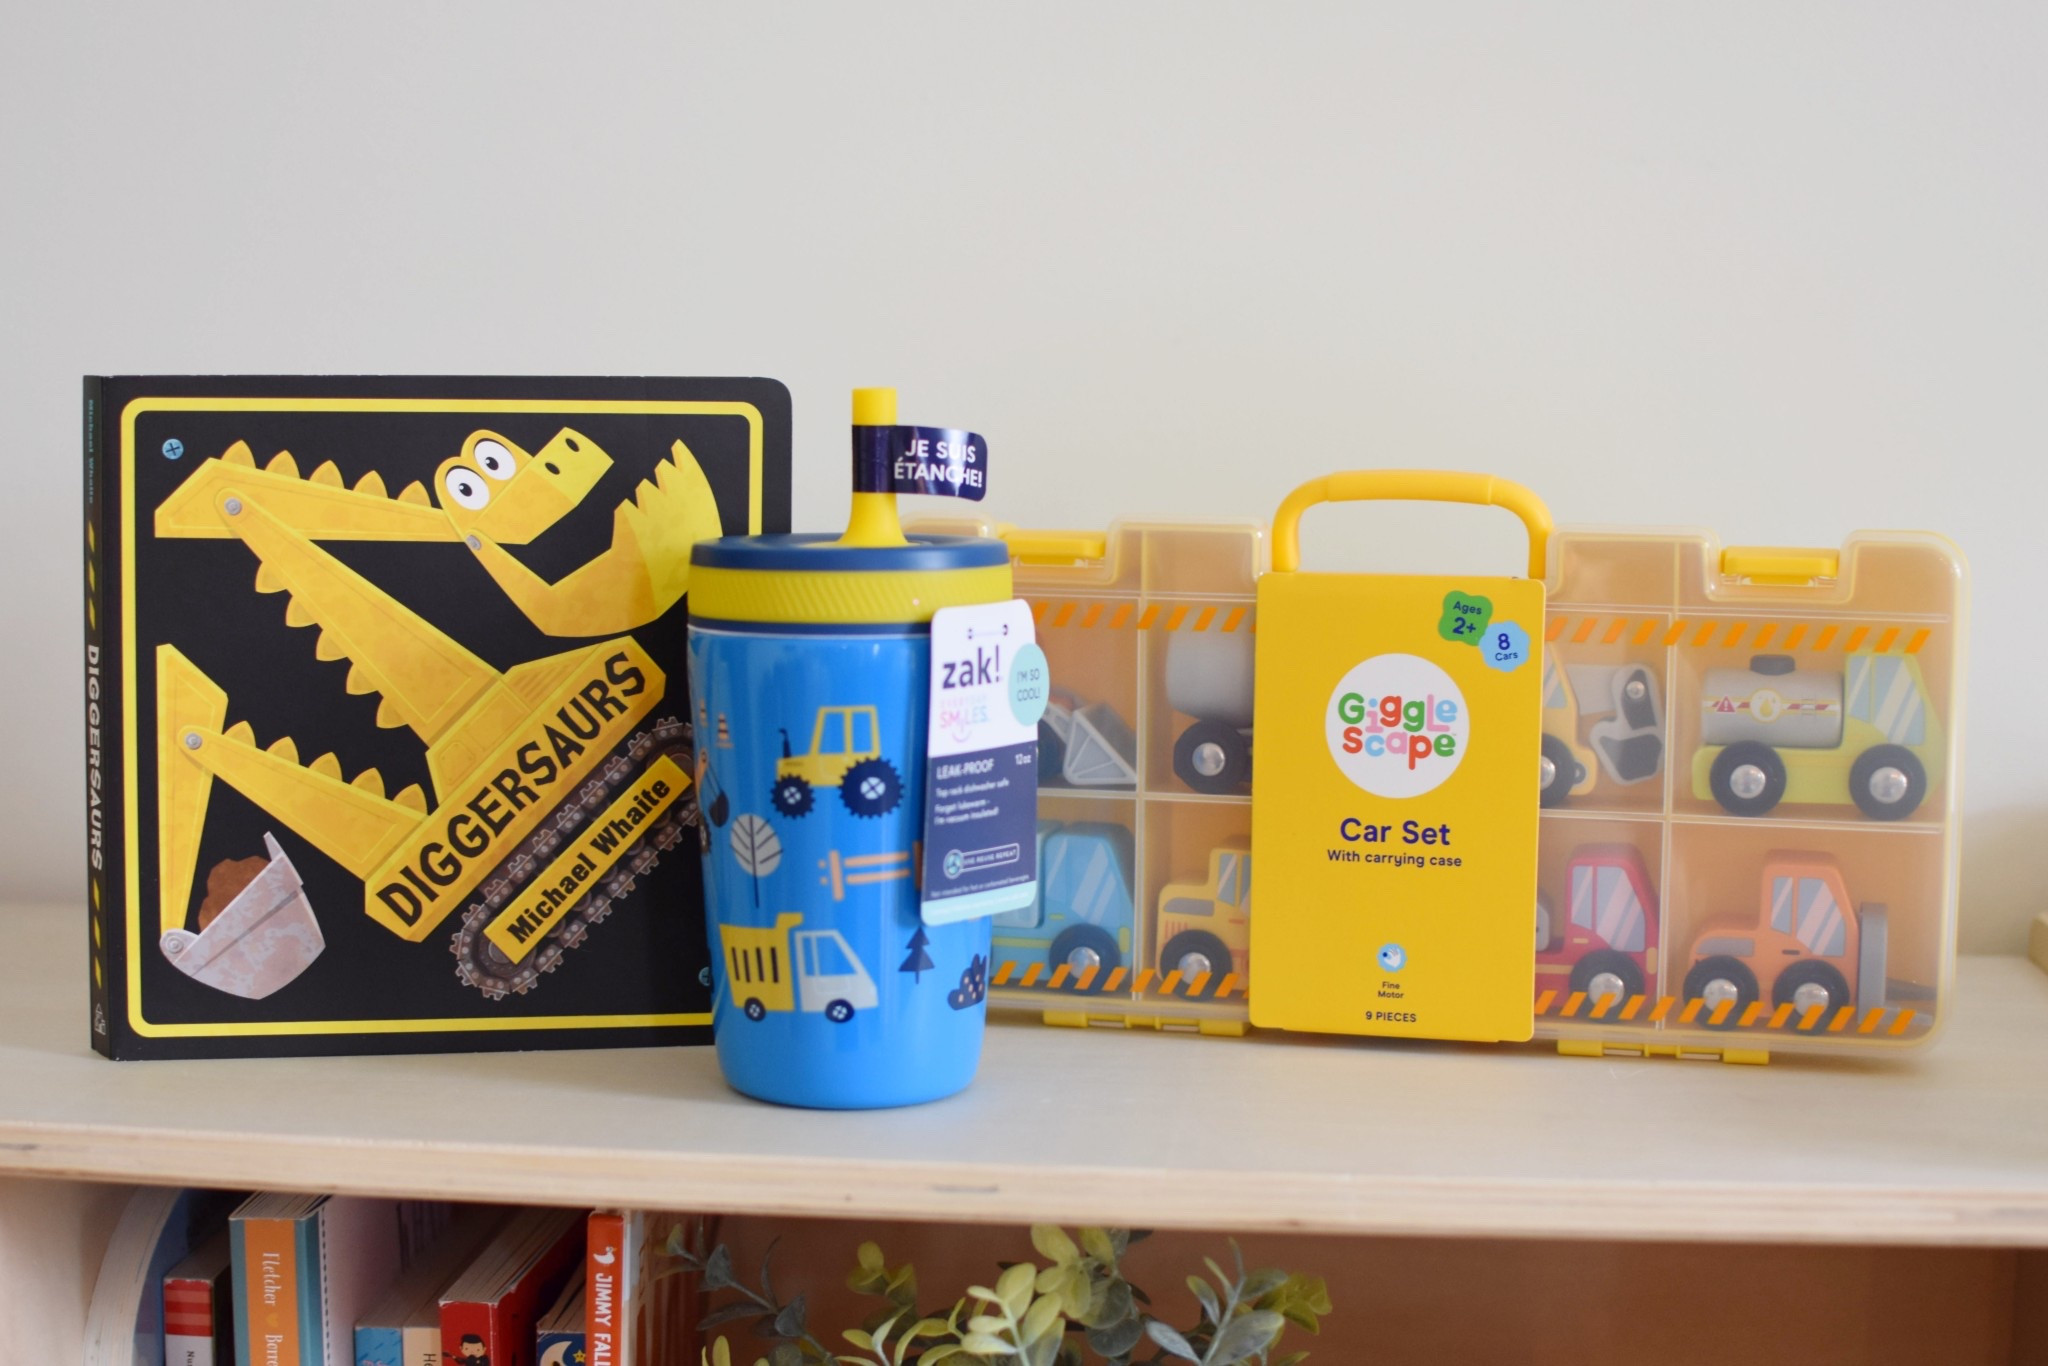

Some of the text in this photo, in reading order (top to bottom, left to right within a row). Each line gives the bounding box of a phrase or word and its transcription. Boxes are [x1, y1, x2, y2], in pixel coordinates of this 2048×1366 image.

[905, 439, 976, 463] JE SUIS
[894, 456, 983, 488] ÉTANCHE!
[1452, 600, 1482, 615] Ages
[1452, 617, 1477, 635] 2+
[1497, 632, 1511, 651] 8
[942, 644, 999, 689] zak!
[1494, 651, 1519, 661] Cars
[1030, 668, 1040, 681] SO
[87, 644, 103, 871] DIGGERSAURS
[936, 758, 995, 781] LEAK-PROOF
[375, 651, 646, 928] DIGGERSAURS
[1340, 817, 1451, 846] Car Set
[505, 778, 672, 945] Michael Whaite
[1327, 849, 1463, 868] With carrying case
[1377, 990, 1405, 999] Motor
[1381, 981, 1401, 990] Fine
[1365, 1011, 1417, 1023] 9 PIECES
[261, 1252, 282, 1306] Fletcher
[594, 1272, 614, 1327] JIMMY
